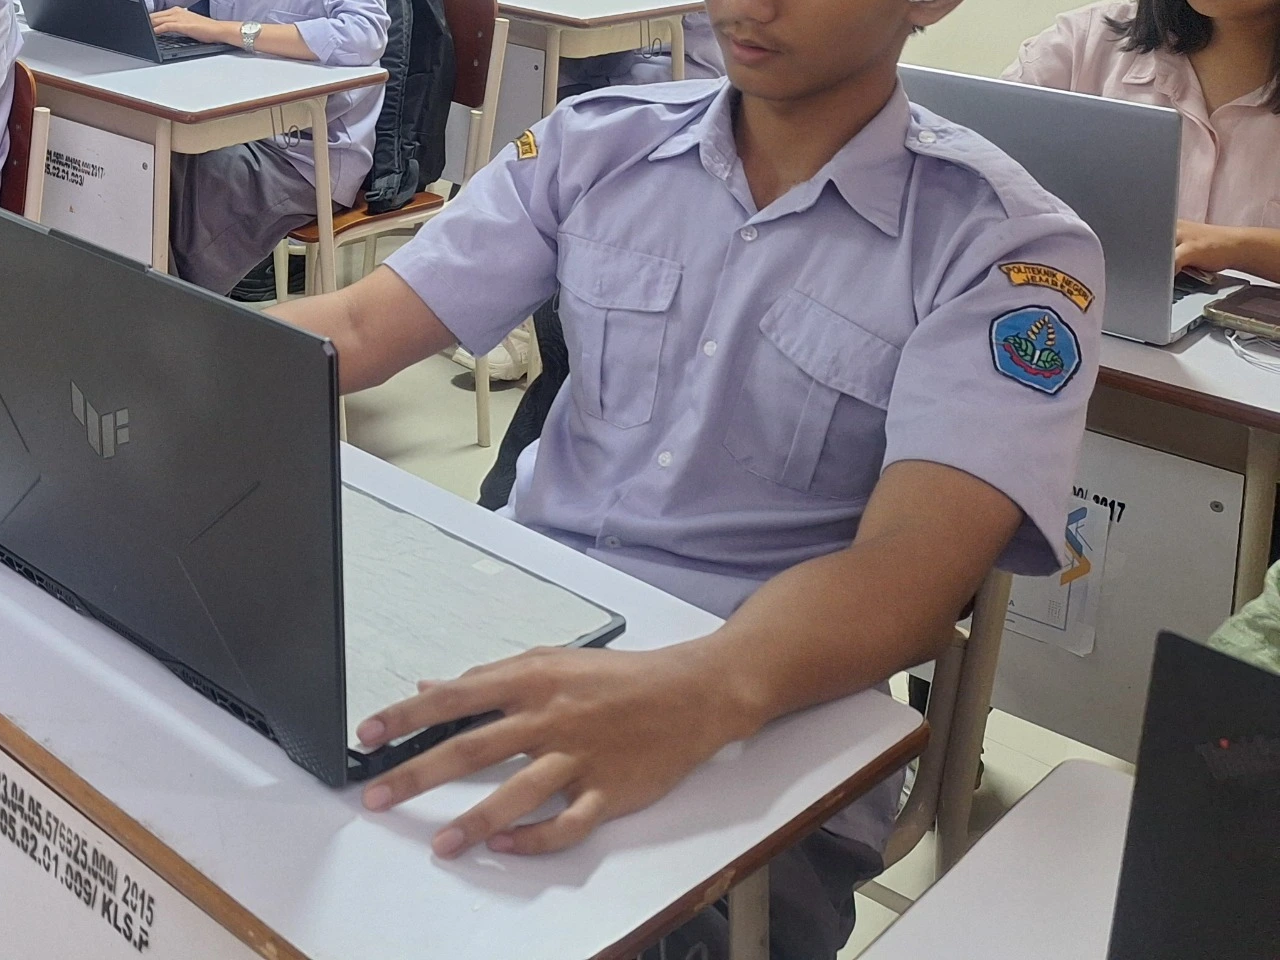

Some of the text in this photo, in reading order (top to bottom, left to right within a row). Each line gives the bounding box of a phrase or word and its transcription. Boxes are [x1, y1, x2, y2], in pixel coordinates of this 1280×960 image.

[1005, 266, 1090, 301] POLITEKNIK NEGERI
[1022, 275, 1074, 297] JEMBER
[122, 874, 155, 928] 2015
